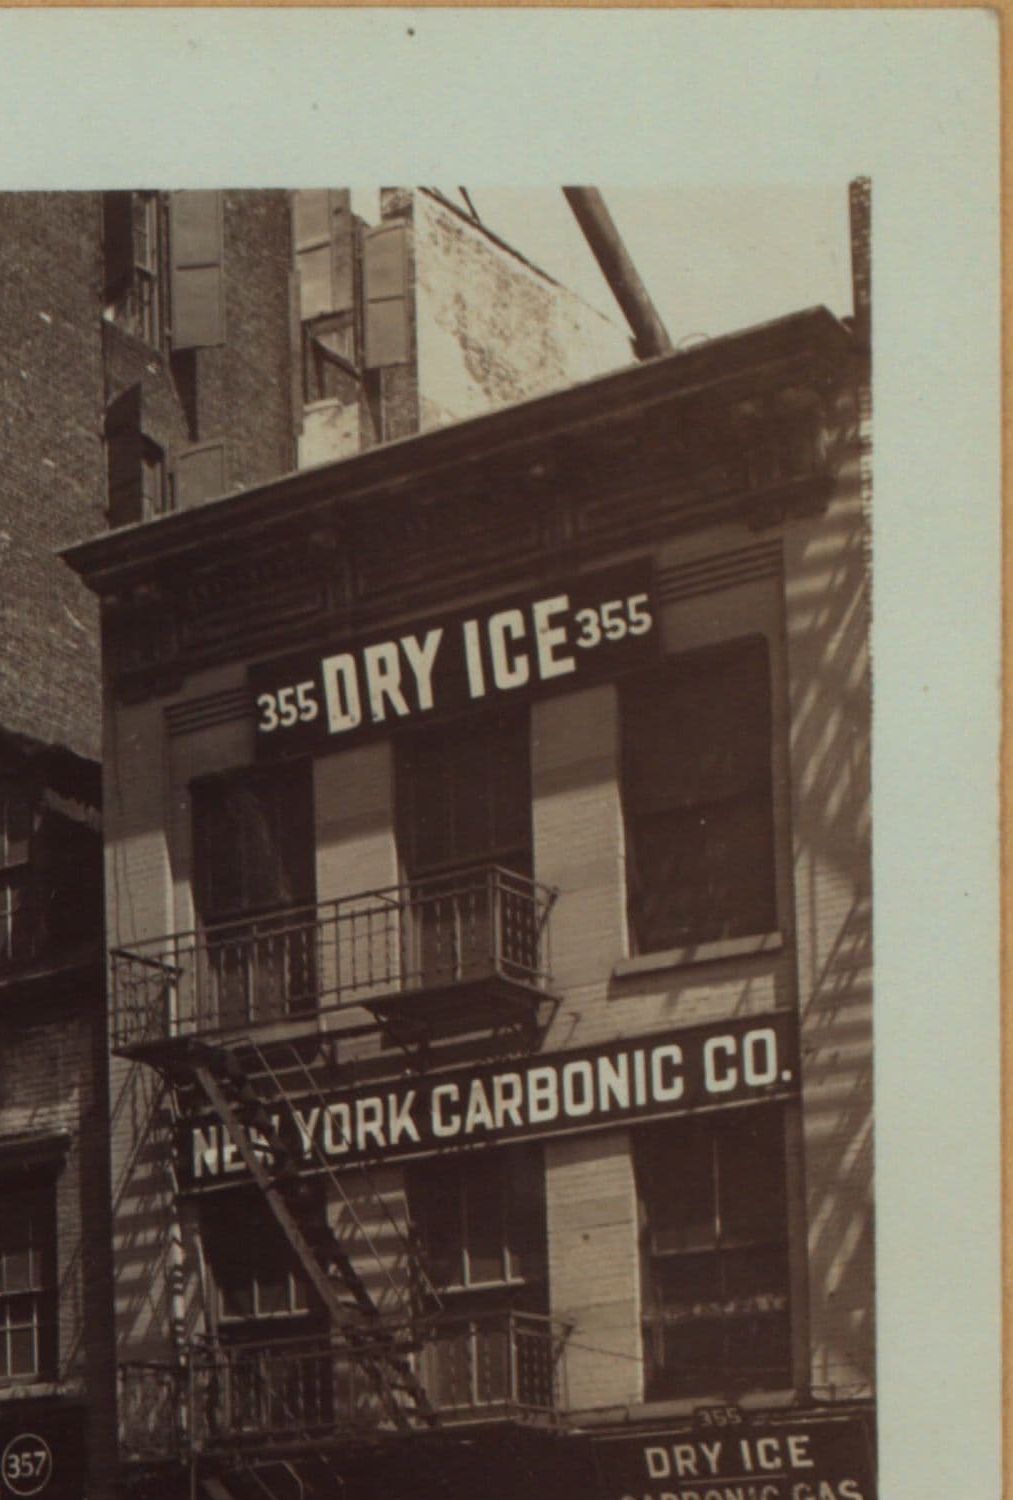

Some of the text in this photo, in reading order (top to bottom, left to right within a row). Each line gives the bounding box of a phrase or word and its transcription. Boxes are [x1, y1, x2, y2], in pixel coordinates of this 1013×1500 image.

[256, 592, 654, 735] 355 DRY ICE 355
[294, 1090, 421, 1159] YORK
[430, 1044, 684, 1138] CARBONIC
[703, 1028, 792, 1094] CO.
[696, 1407, 743, 1427] 355
[6, 1450, 47, 1480] 357
[644, 1434, 815, 1480] DRY ICE
